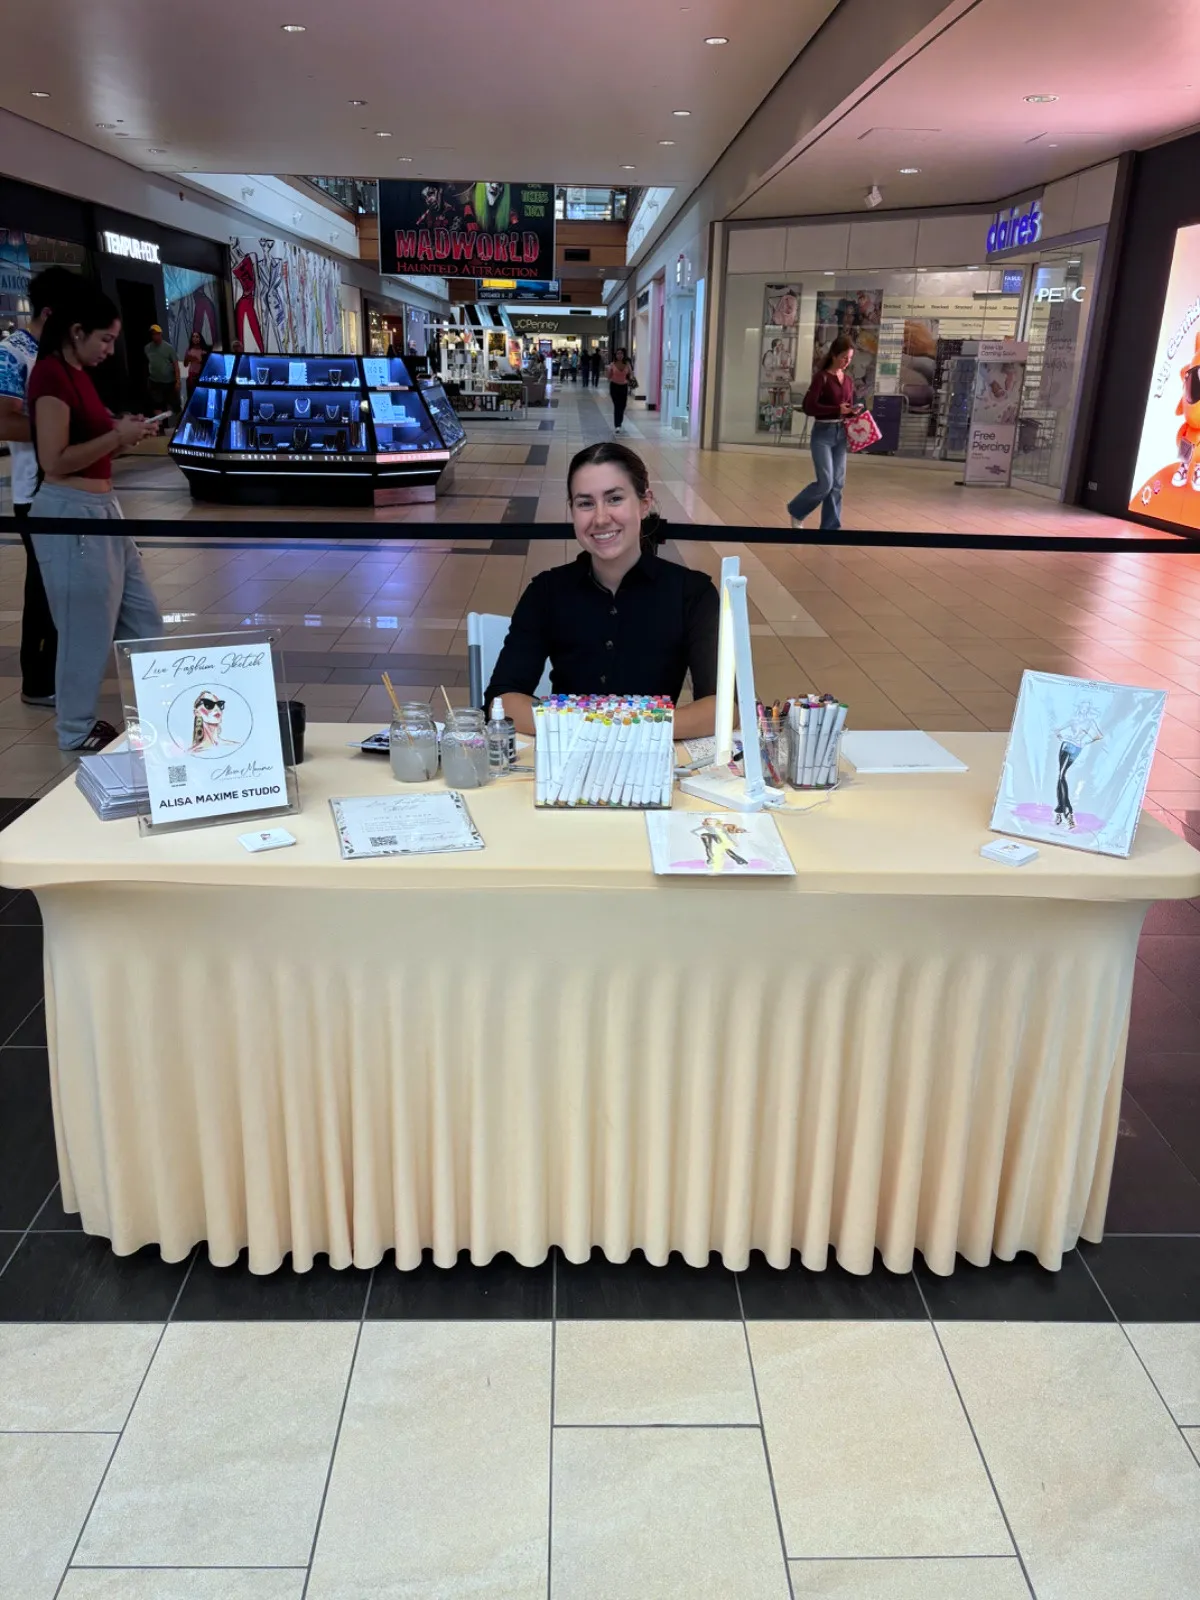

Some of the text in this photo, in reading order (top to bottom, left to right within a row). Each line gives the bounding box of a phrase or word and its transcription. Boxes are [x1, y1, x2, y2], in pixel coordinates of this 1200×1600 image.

[986, 201, 1041, 254] claire's
[394, 227, 540, 263] MADWORLD
[396, 261, 538, 277] HAUNTED ATTRACTION
[514, 318, 559, 331] JCPenney
[973, 430, 995, 440] Free
[972, 441, 1010, 453] Piercing
[172, 655, 215, 678] Fashion
[220, 652, 265, 674] Sketch
[159, 785, 281, 809] ALISA MAXIME STUDIO
